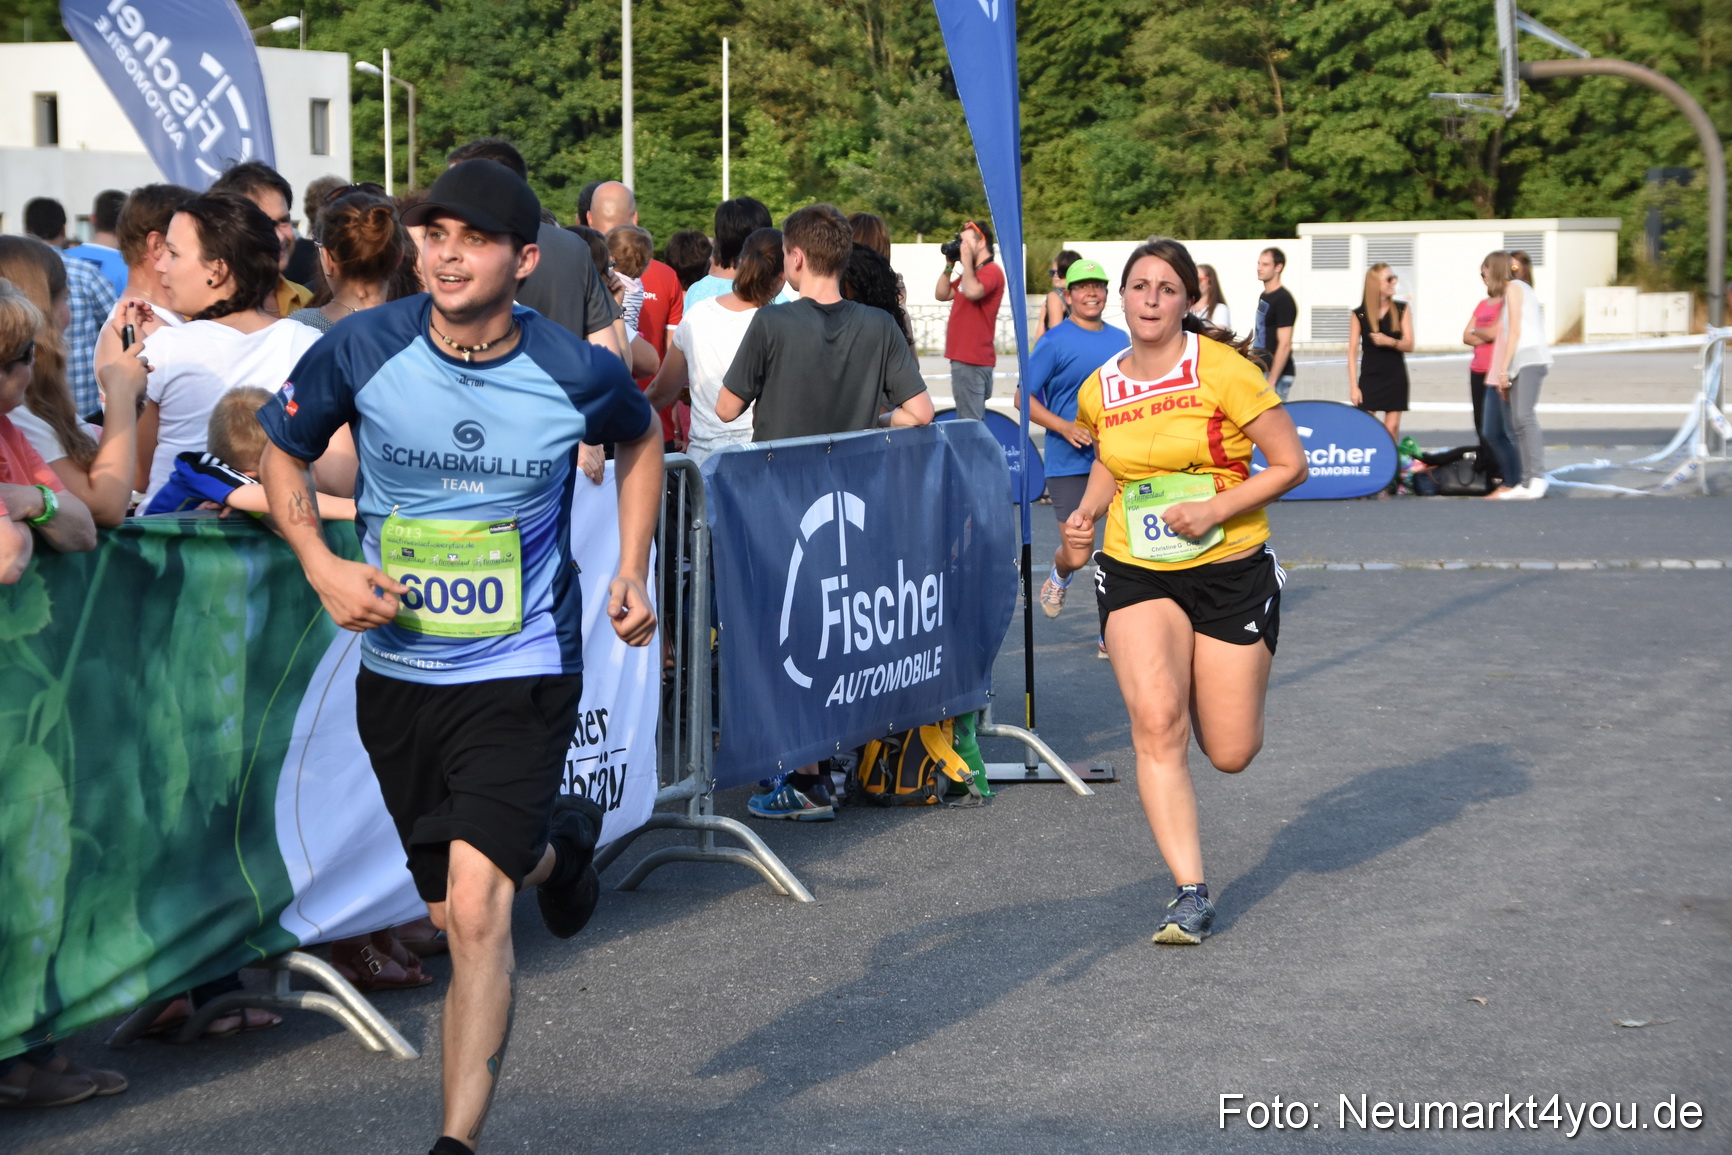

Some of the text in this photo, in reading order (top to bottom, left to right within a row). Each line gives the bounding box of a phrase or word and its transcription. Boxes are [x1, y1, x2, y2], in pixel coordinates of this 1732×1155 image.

[1105, 395, 1203, 428] MAX BÖGL
[381, 443, 553, 479] SCHABMÜLLER
[441, 477, 484, 494] TEAM
[386, 523, 423, 539] 2013
[1151, 543, 1177, 553] Christine
[400, 573, 504, 615] 6090
[825, 645, 942, 708] AUTOMOBILE
[560, 750, 627, 813] bräu
